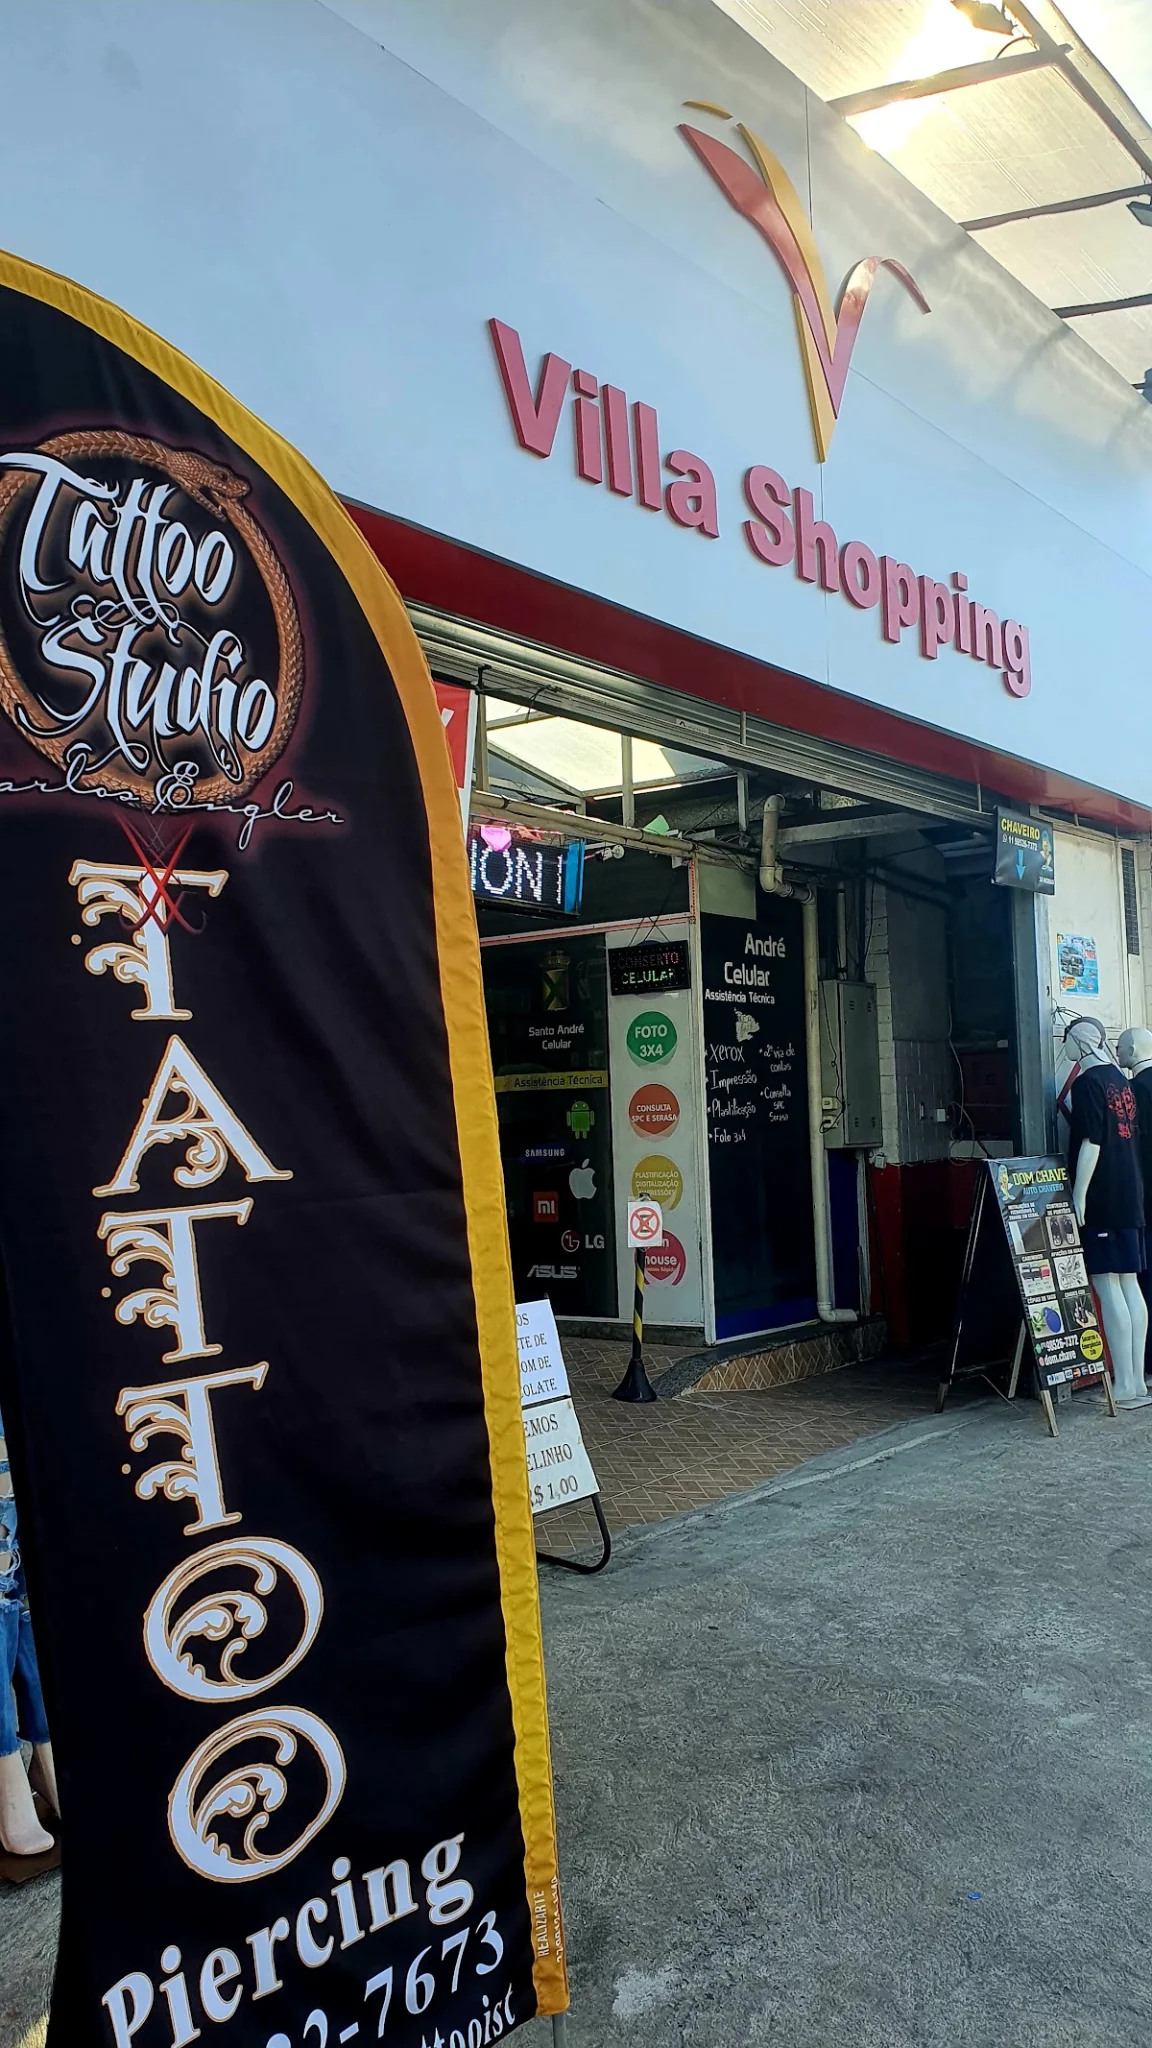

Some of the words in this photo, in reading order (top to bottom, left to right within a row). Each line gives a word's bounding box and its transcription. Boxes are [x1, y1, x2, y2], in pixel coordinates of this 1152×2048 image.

[489, 317, 719, 538] Villa
[743, 464, 1031, 697] Shopping
[0, 452, 234, 630] Tattoo
[18, 614, 276, 782] Studio
[152, 761, 344, 850] Engler
[1001, 818, 1040, 840] CHAVEIRO
[744, 932, 786, 958] André
[622, 969, 675, 985] CELULAR
[724, 961, 770, 987] Celular
[704, 988, 747, 1003] Assistência
[749, 992, 775, 1004] Técnica
[529, 1026, 555, 1037] Santo
[557, 1023, 585, 1035] André
[634, 1024, 668, 1039] FOTO
[541, 1039, 572, 1050] Celular
[639, 1044, 664, 1057] 3X4
[785, 1042, 796, 1056] de
[709, 1043, 745, 1063] Xerox
[514, 1076, 565, 1088] Assistência
[566, 1074, 603, 1086] Técnica
[709, 1069, 758, 1094] Impressão
[636, 1104, 671, 1112] CONSULTA
[631, 1115, 645, 1123] SPC
[646, 1114, 650, 1122] E
[651, 1113, 678, 1122] SERASA
[733, 1128, 746, 1143] 3x4
[525, 1148, 565, 1157] SAMSUNG
[635, 1170, 679, 1179] PLASTIFICAÇÃO
[1012, 1171, 1034, 1186] DOM
[1035, 1167, 1068, 1183] CHAVE
[635, 1180, 679, 1188] DIGITALIZAÇÃO
[1023, 1186, 1038, 1195] AUTO
[585, 1234, 605, 1249] LG
[526, 1264, 578, 1279] ASUS
[533, 1333, 547, 1347] DE
[68, 858, 347, 1884] TATTOO
[538, 1356, 552, 1370] DE
[526, 1443, 573, 1472] ELINHO
[547, 1475, 578, 1500] 1,00
[533, 1890, 550, 1957] REALIZARTE
[101, 1832, 474, 2048] Piercing
[265, 1910, 504, 2048] 2-7673
